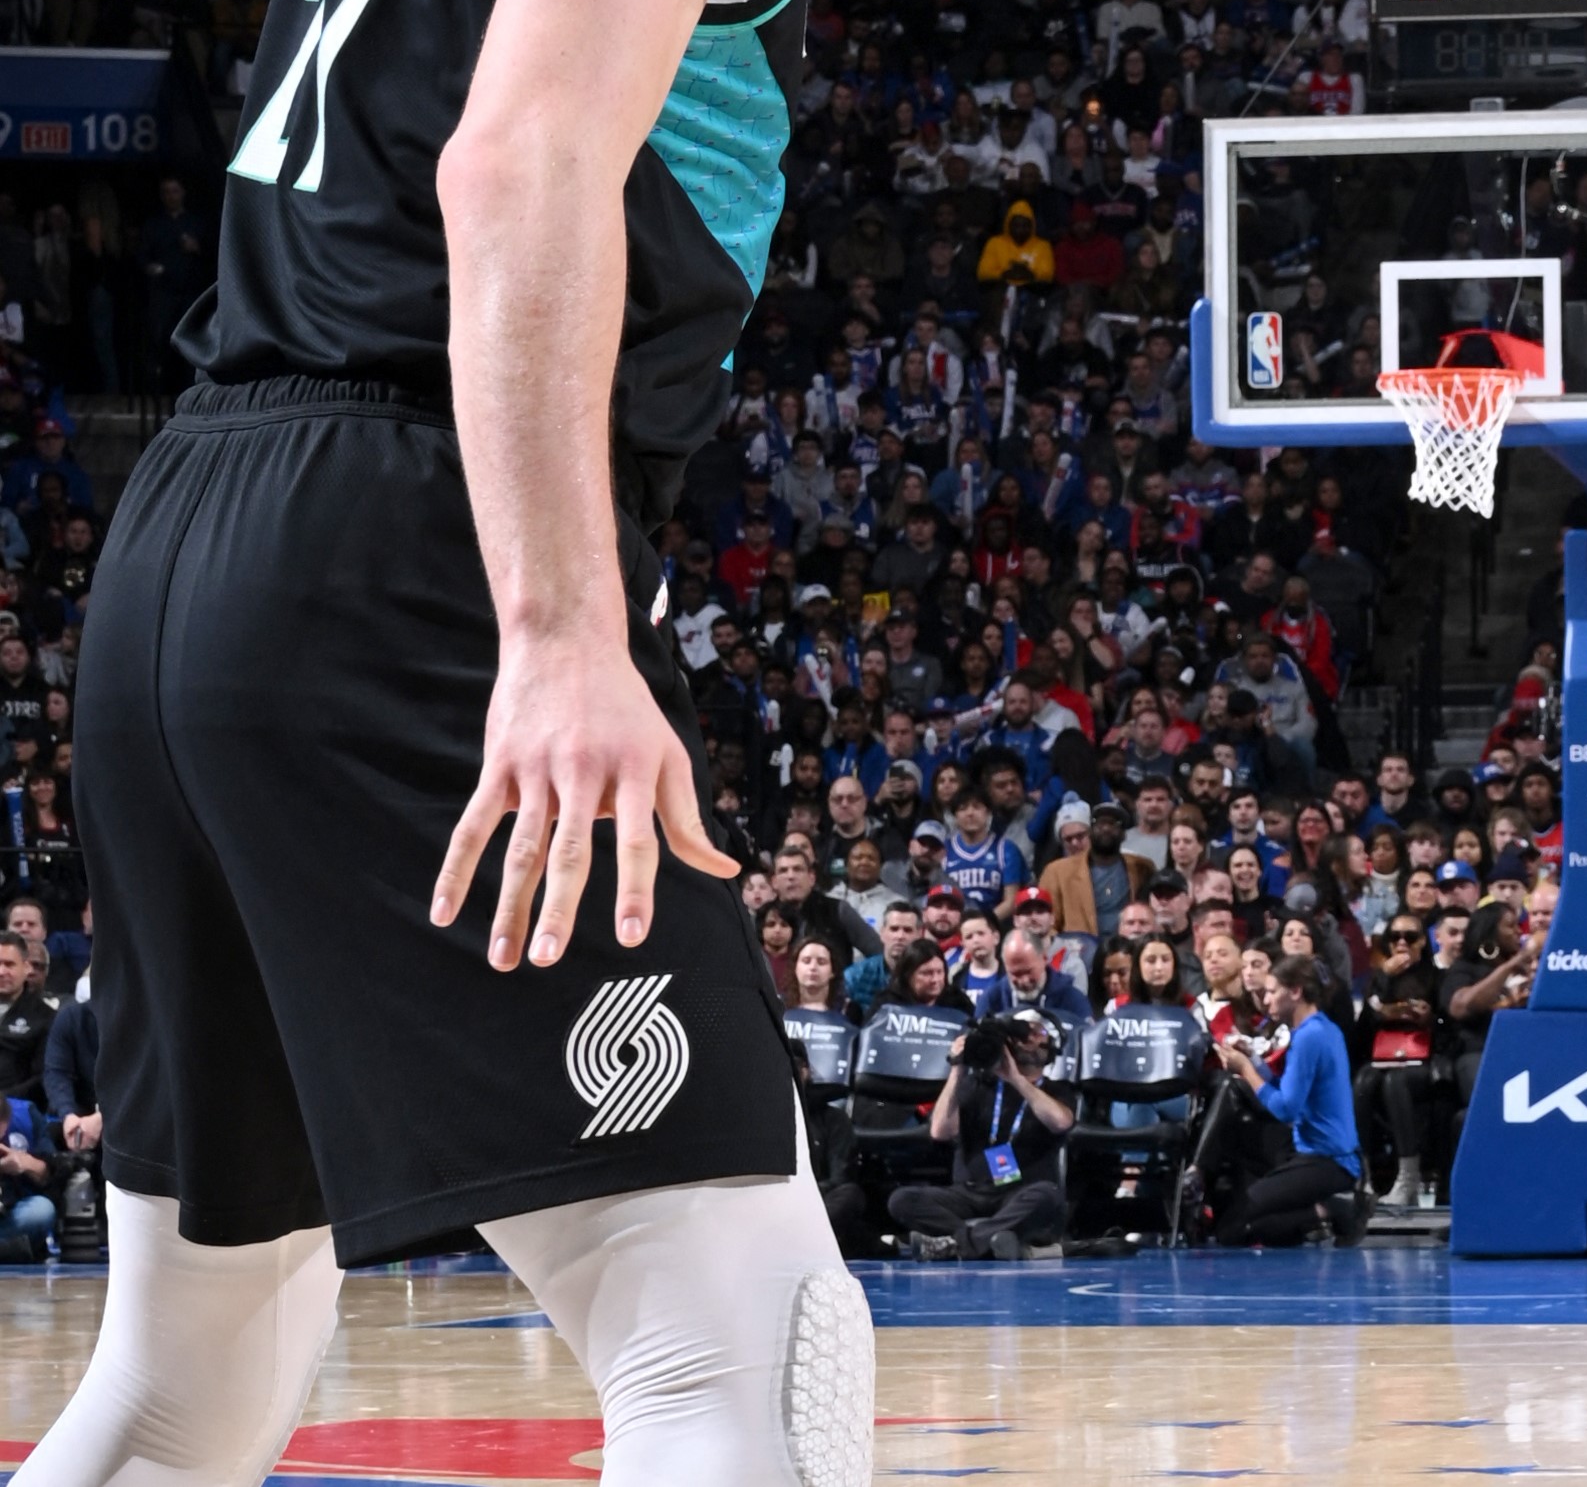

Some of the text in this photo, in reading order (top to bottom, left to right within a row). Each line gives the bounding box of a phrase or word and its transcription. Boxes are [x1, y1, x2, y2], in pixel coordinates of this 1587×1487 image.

[82, 112, 159, 153] 108
[886, 1012, 928, 1036] NJM
[1106, 1018, 1149, 1040] NJM
